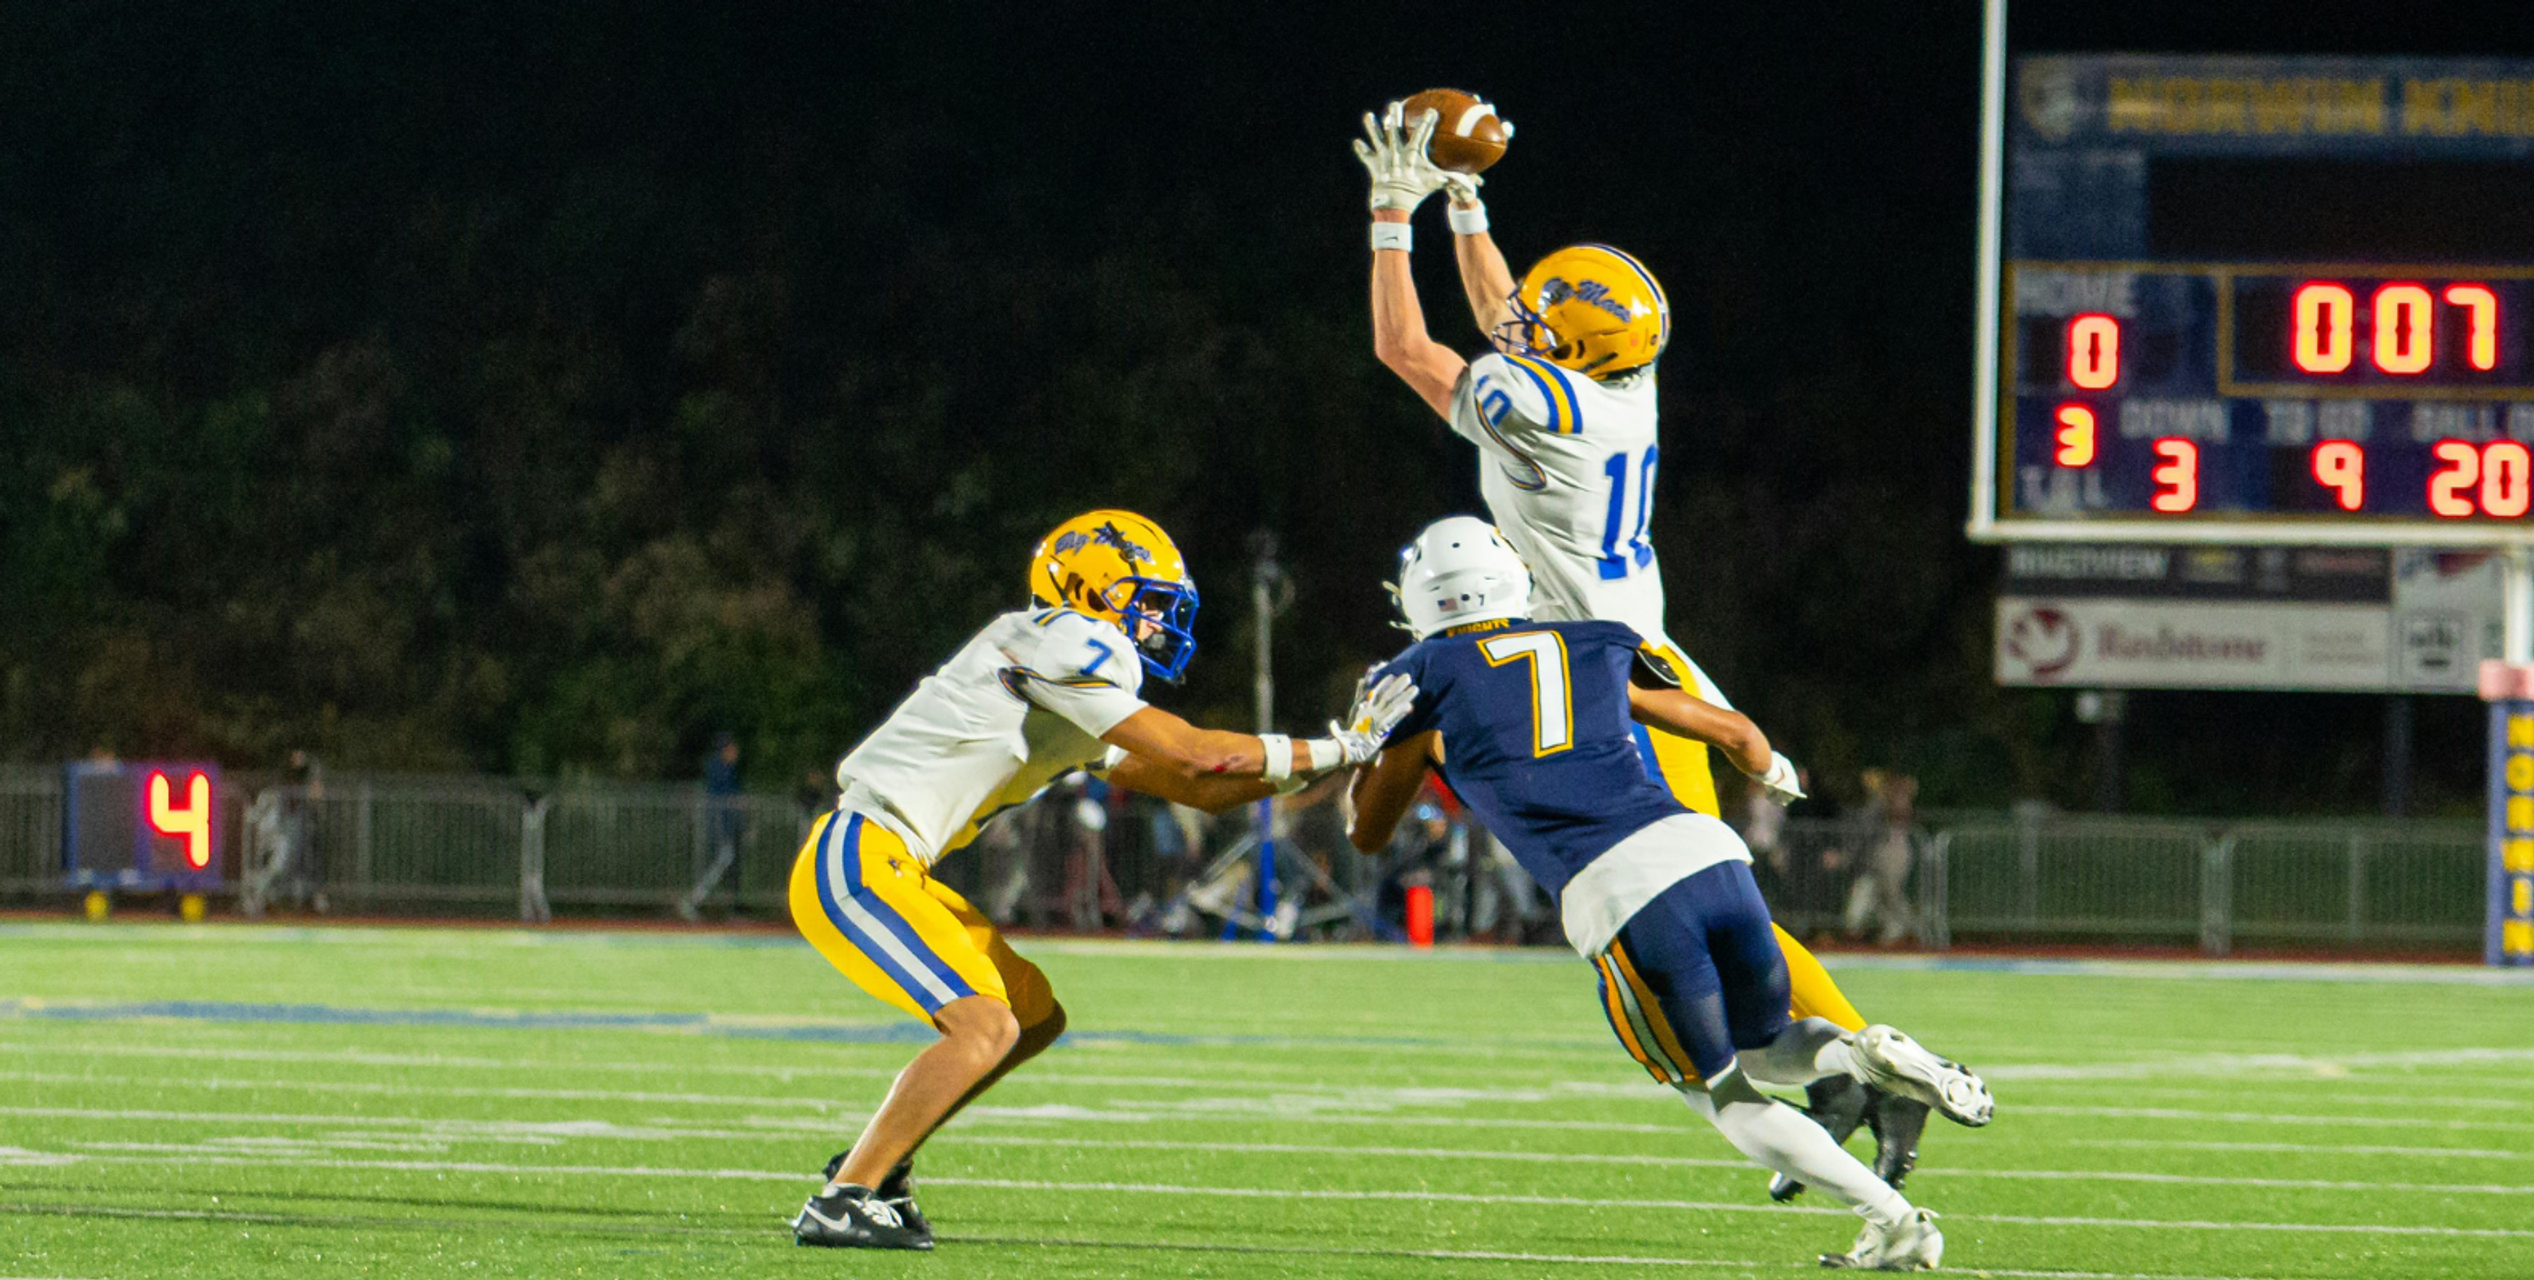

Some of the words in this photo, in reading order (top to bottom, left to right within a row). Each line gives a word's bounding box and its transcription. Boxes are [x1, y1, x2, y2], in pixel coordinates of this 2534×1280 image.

[2067, 312, 2120, 390] 0
[2054, 403, 2096, 467] 3
[1597, 443, 1659, 580] 10
[2151, 437, 2198, 512] 3
[2312, 440, 2364, 511] 9
[2427, 439, 2531, 518] 20
[1080, 638, 1113, 676] 7
[1476, 630, 1574, 758] 7
[147, 770, 211, 867] 4
